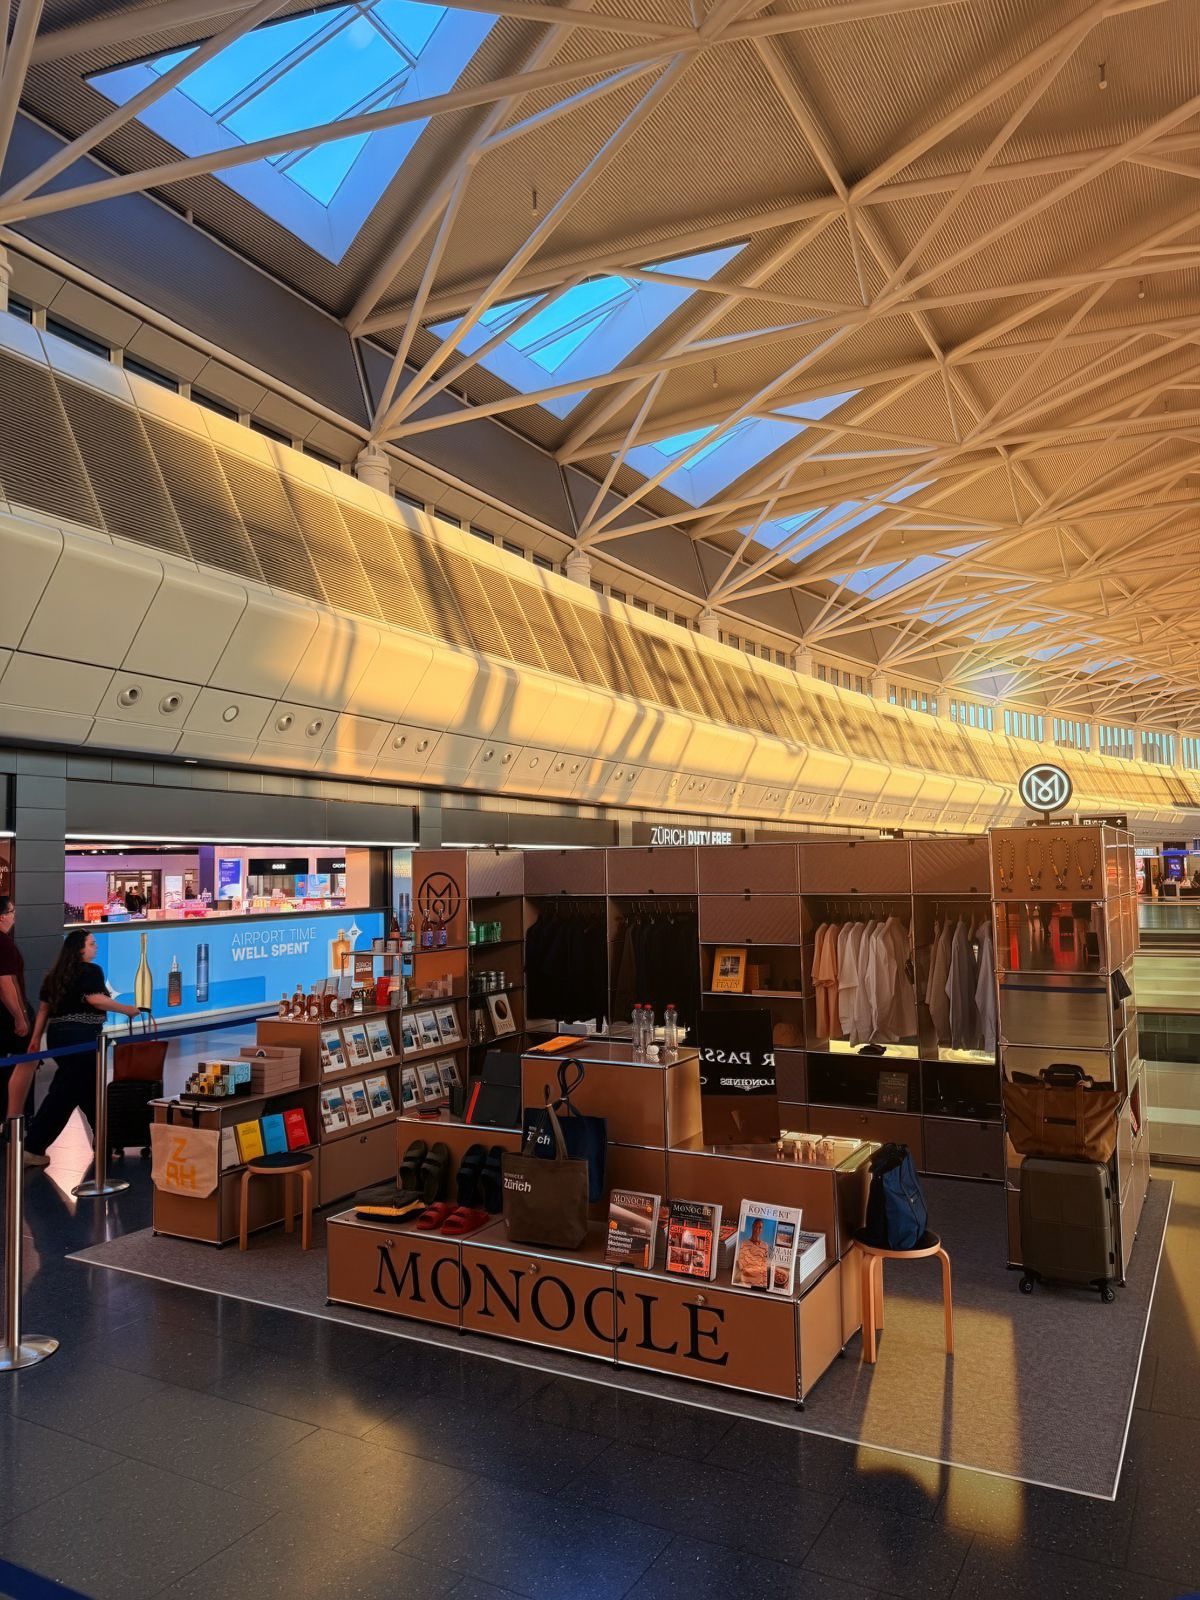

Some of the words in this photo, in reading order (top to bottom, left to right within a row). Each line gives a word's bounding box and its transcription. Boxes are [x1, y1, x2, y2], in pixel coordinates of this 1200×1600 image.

[651, 826, 686, 845] ZÜRICH
[688, 831, 710, 845] DUTY
[712, 832, 732, 845] FREE
[231, 930, 285, 946] AIRPORT
[290, 927, 317, 941] TIME
[232, 946, 268, 962] WELL
[271, 941, 309, 957] SPENT
[504, 1178, 532, 1193] Zürich
[614, 1194, 651, 1207] MONOCLE
[673, 1204, 712, 1216] MONOCLE
[748, 1205, 791, 1219] KONFEKT
[373, 1245, 730, 1367] MONOCLE
